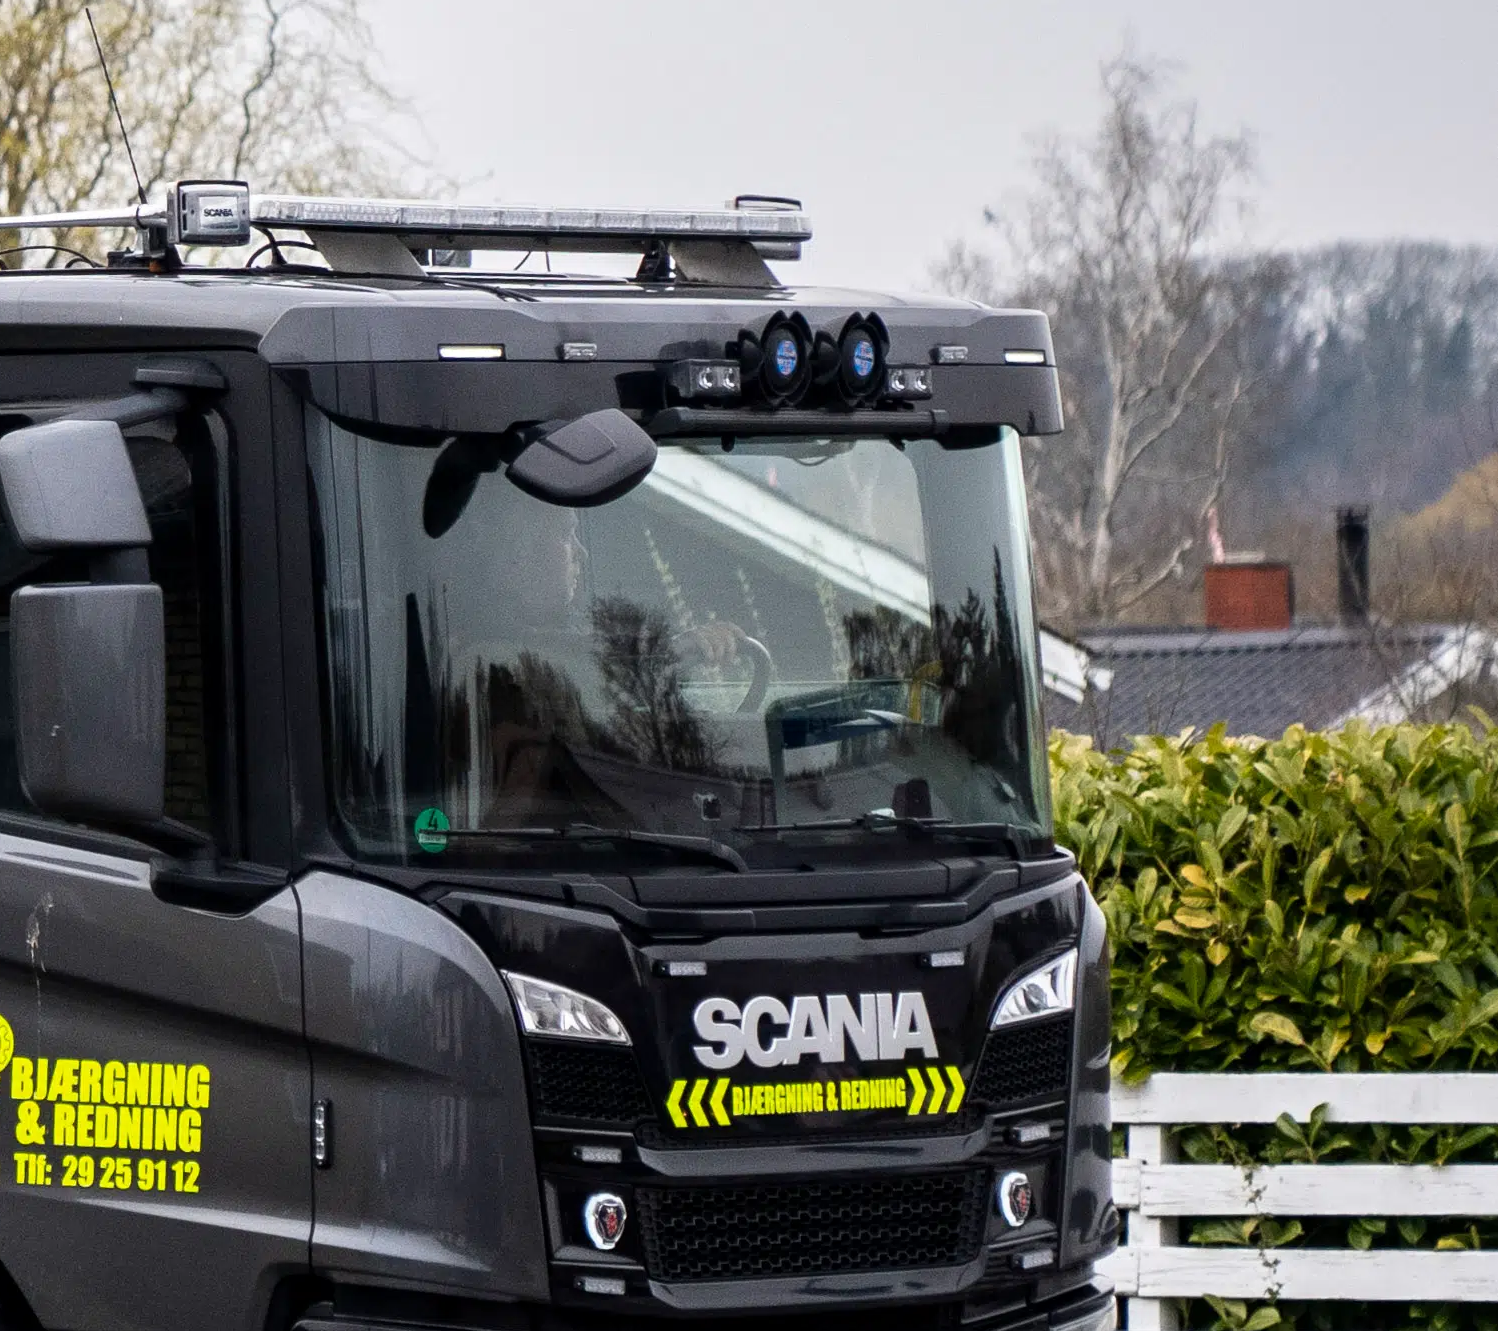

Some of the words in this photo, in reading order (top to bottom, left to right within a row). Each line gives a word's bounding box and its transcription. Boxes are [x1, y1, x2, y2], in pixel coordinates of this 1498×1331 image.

[693, 992, 939, 1069] SCANIA
[11, 1057, 211, 1108] BJÆRGNING
[732, 1083, 824, 1116] BJÆRGNING
[826, 1081, 838, 1111] &
[840, 1077, 906, 1110] REDNING
[15, 1100, 46, 1145] &
[53, 1103, 202, 1152] REDNING
[13, 1153, 52, 1185] Tlf:
[61, 1154, 94, 1187] 29
[99, 1156, 132, 1189] 25
[137, 1158, 166, 1191] 91
[171, 1160, 200, 1193] 12
